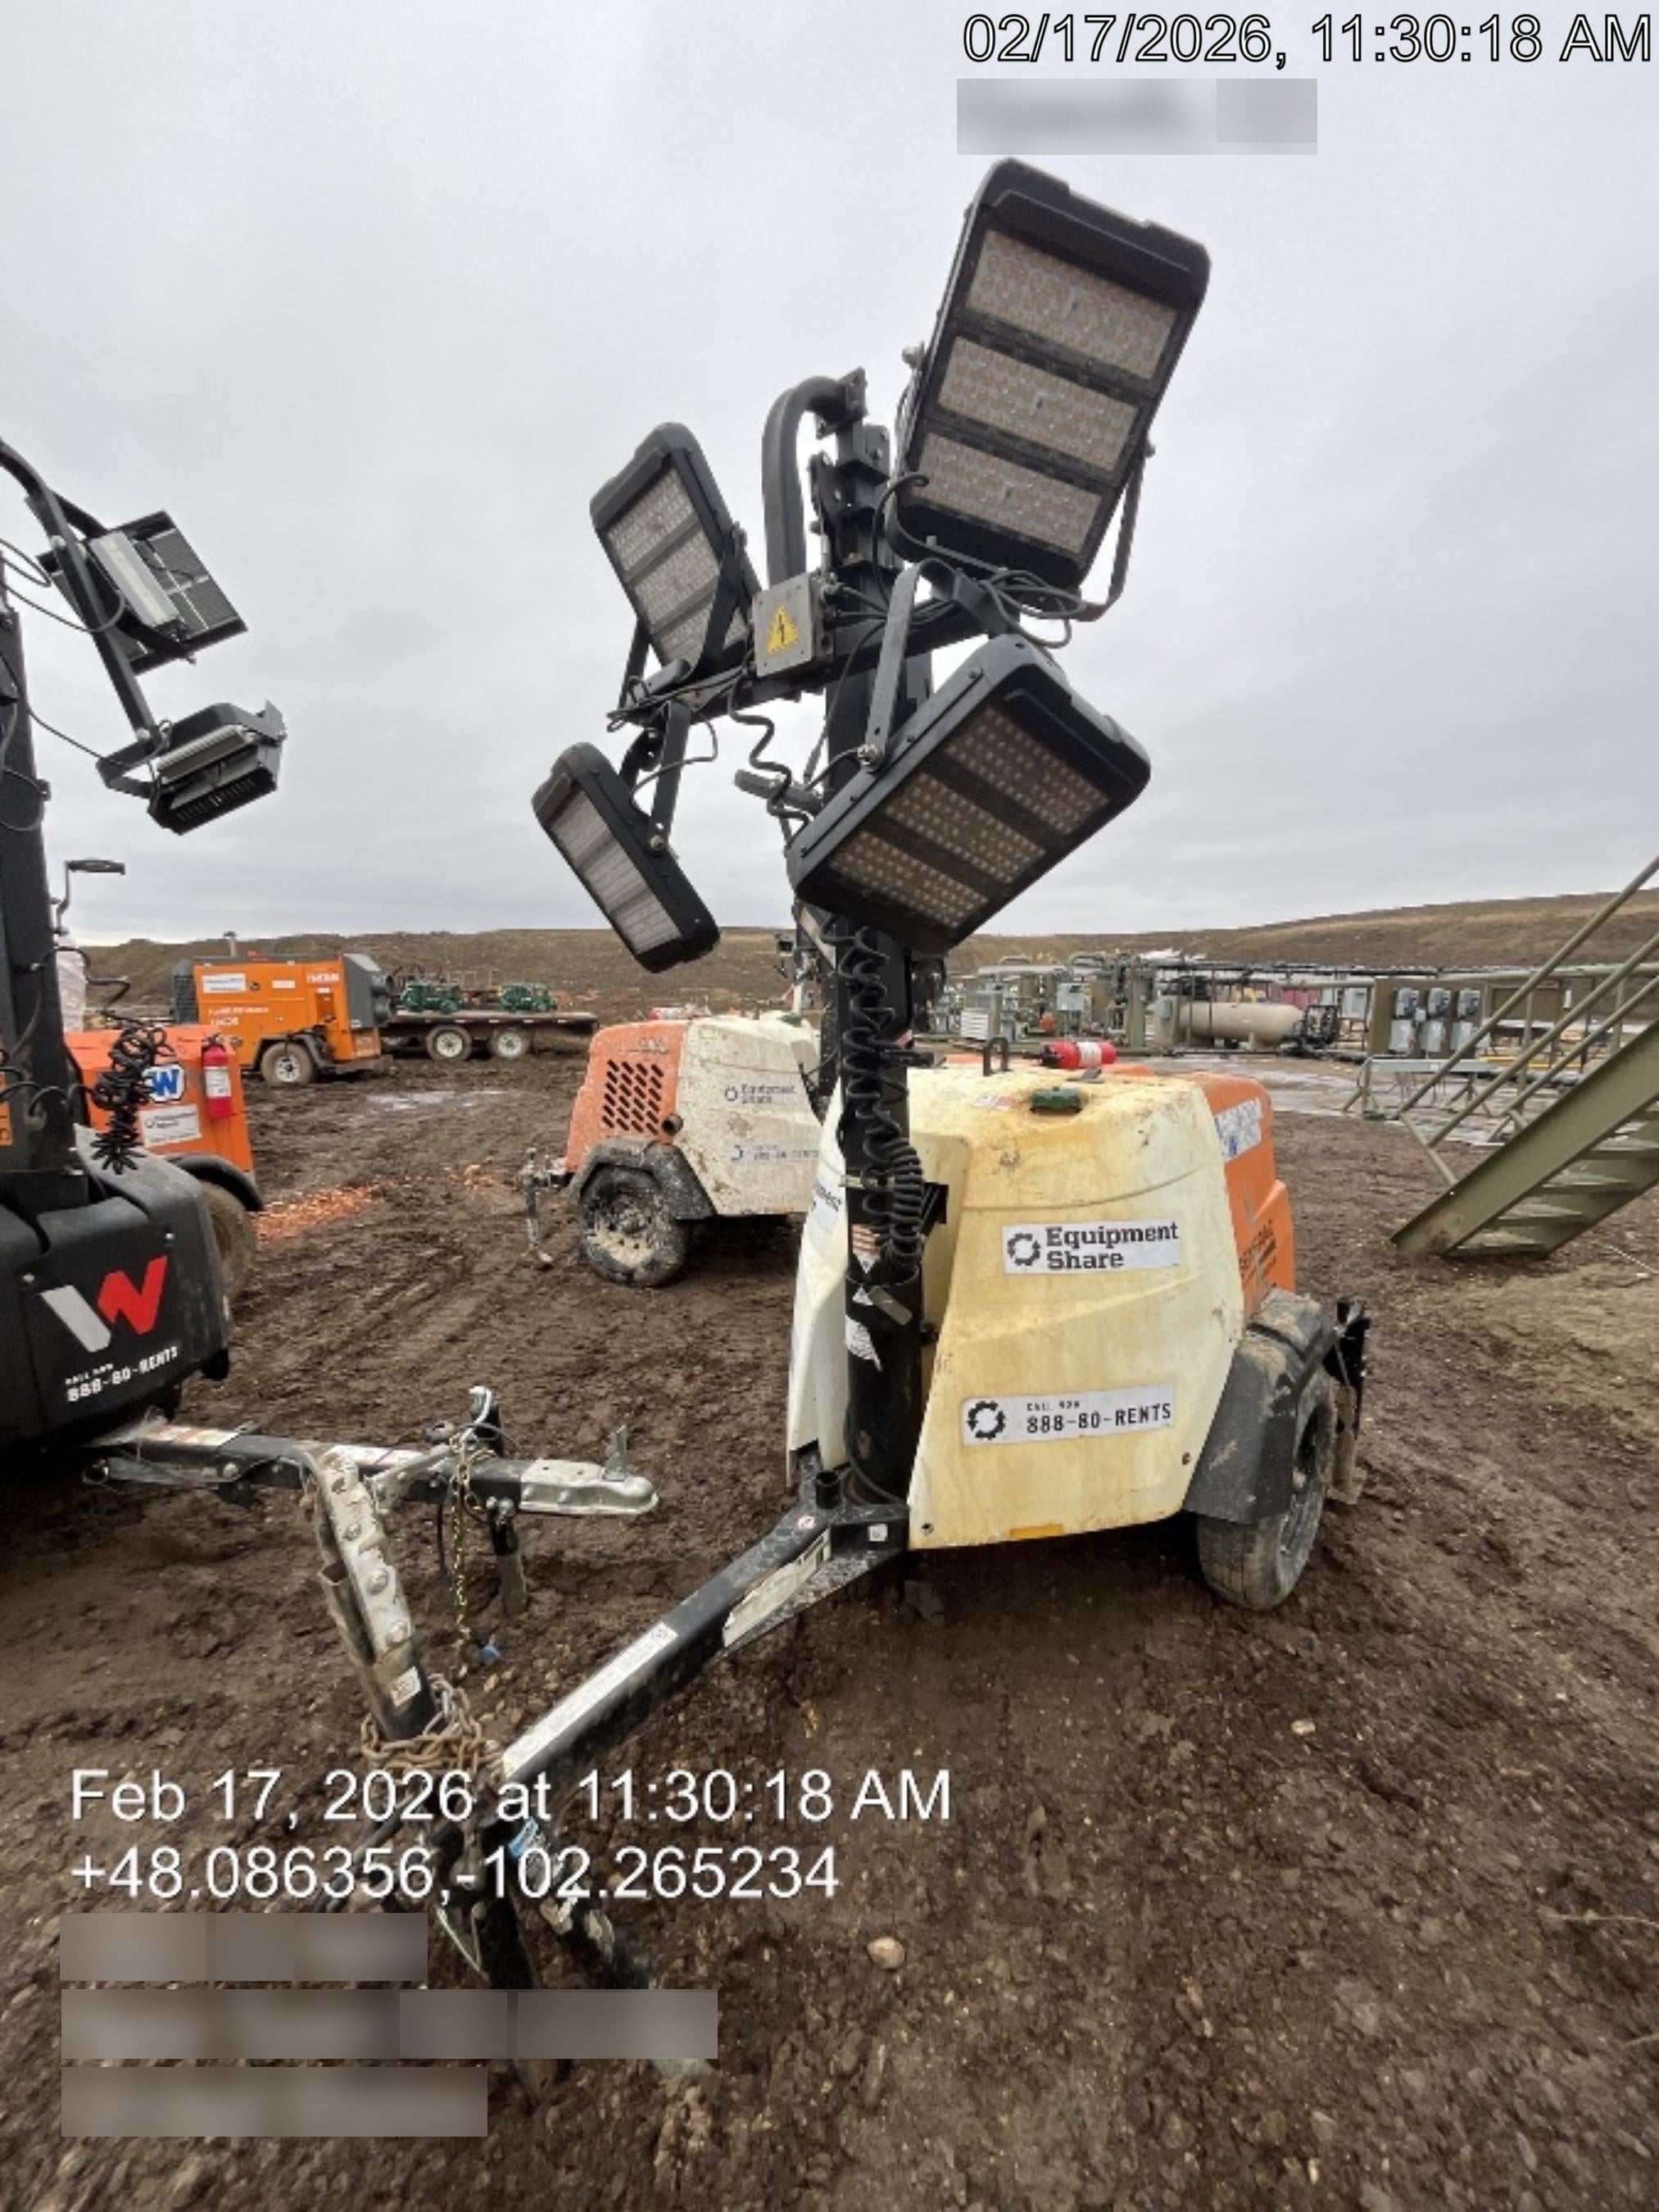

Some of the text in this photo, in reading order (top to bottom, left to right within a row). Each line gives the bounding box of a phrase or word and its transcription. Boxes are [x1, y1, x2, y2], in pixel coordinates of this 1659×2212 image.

[1045, 1221, 1179, 1249] Equipment
[1045, 1250, 1125, 1270] Share
[1026, 1402, 1172, 1434] 888-80-RENTS
